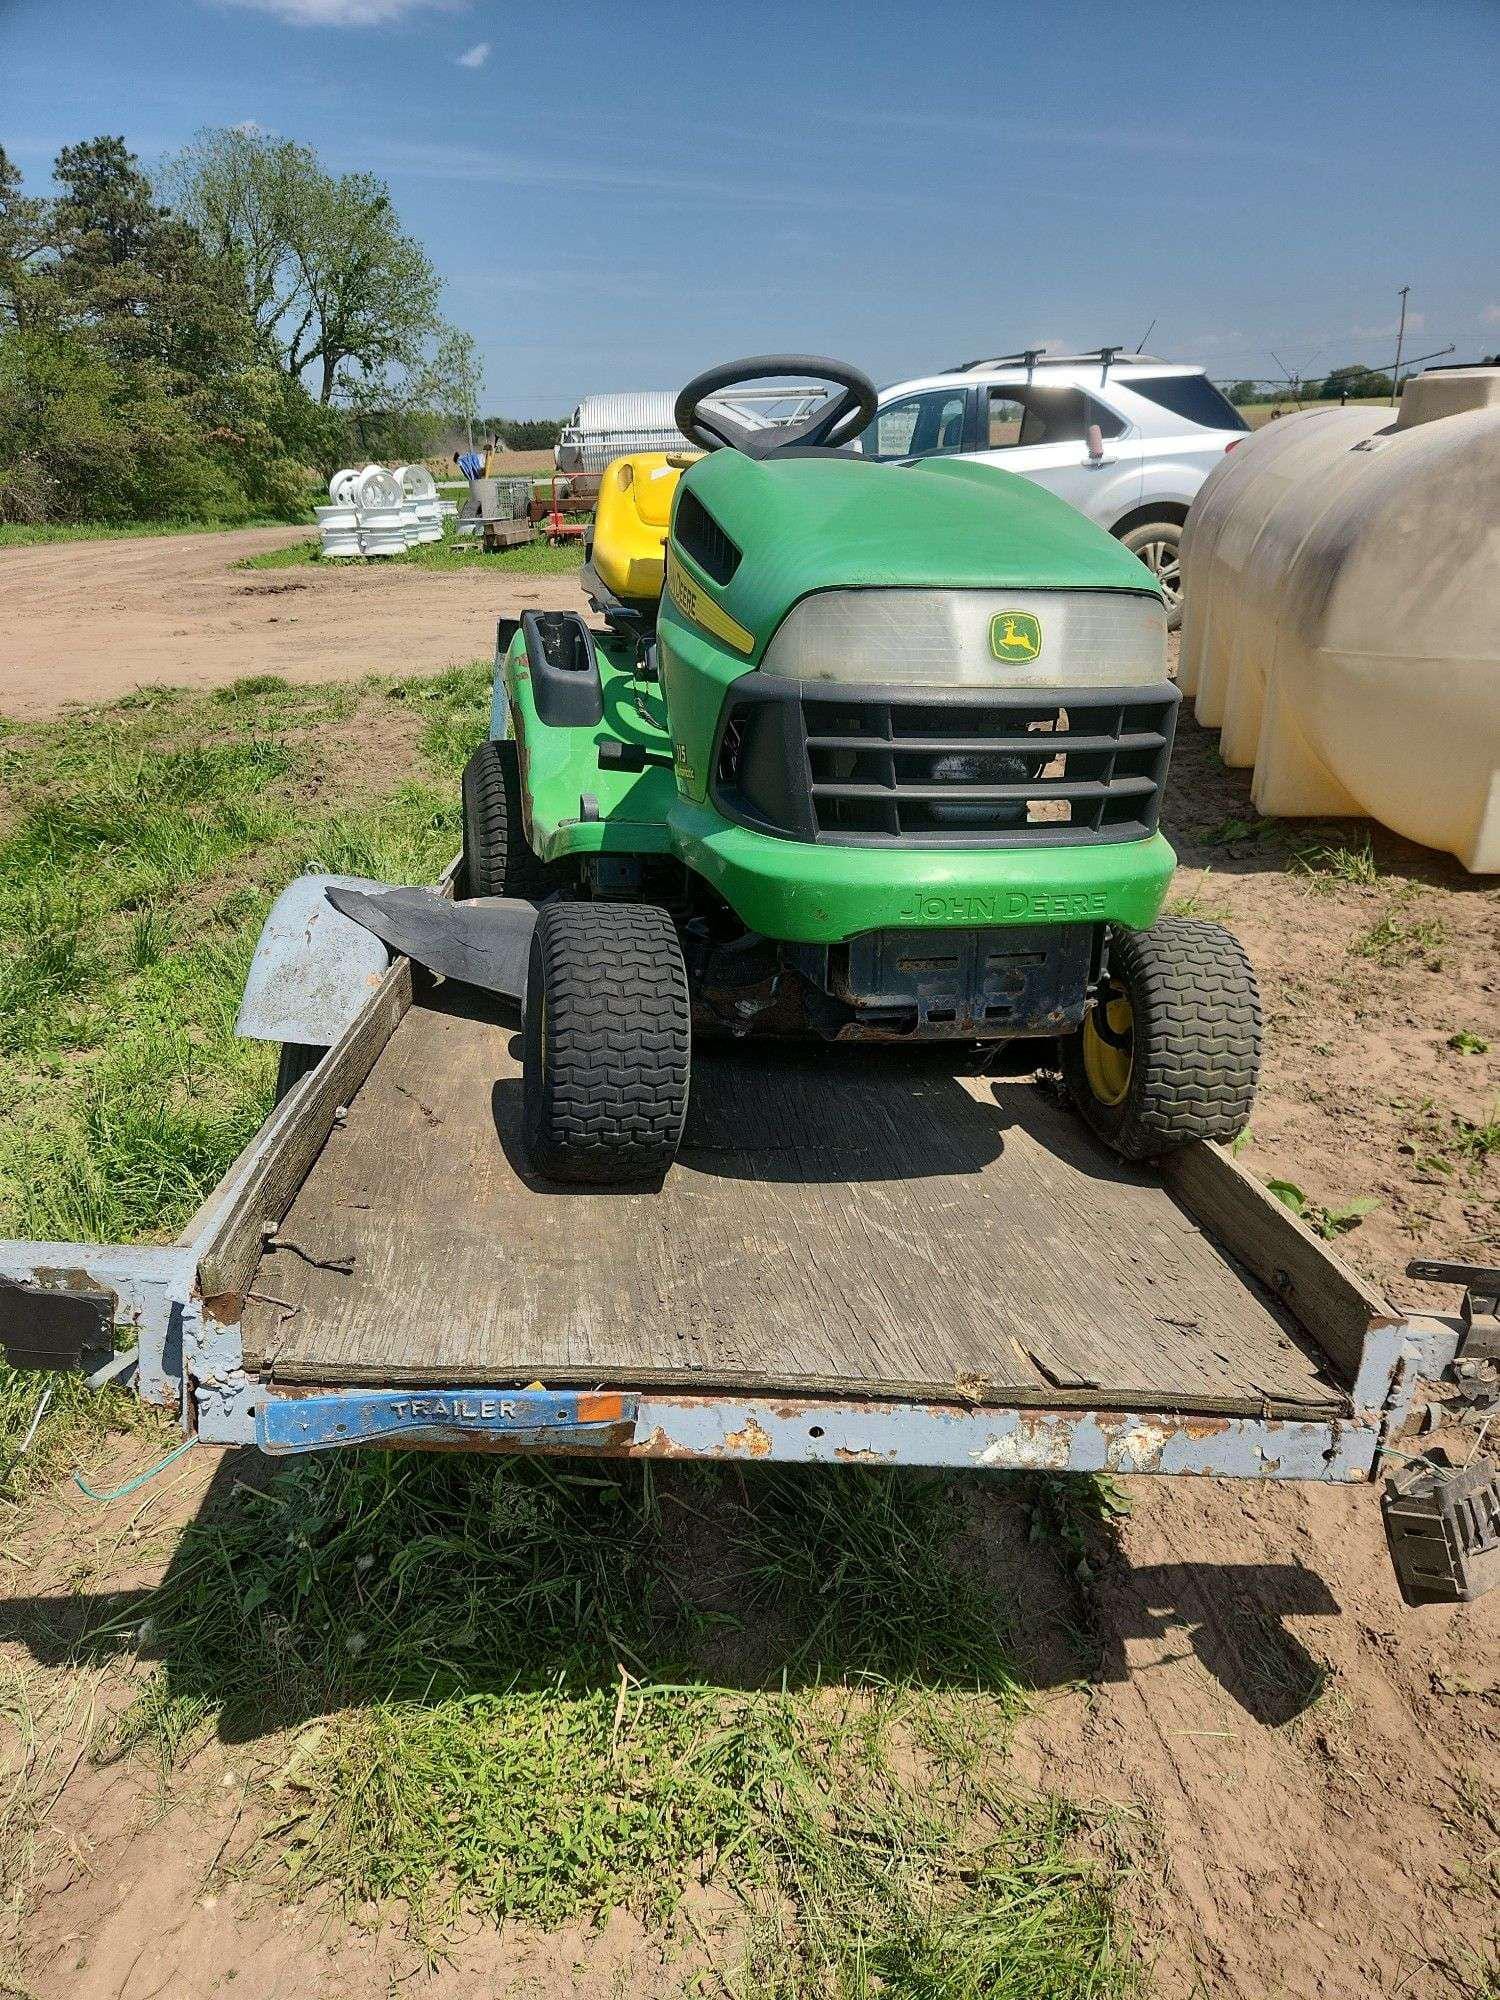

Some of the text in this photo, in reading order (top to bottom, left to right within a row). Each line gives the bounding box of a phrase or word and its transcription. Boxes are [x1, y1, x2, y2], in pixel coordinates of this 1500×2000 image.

[900, 892, 1108, 919] JOHN DEERE
[389, 1400, 518, 1421] TRAILER
